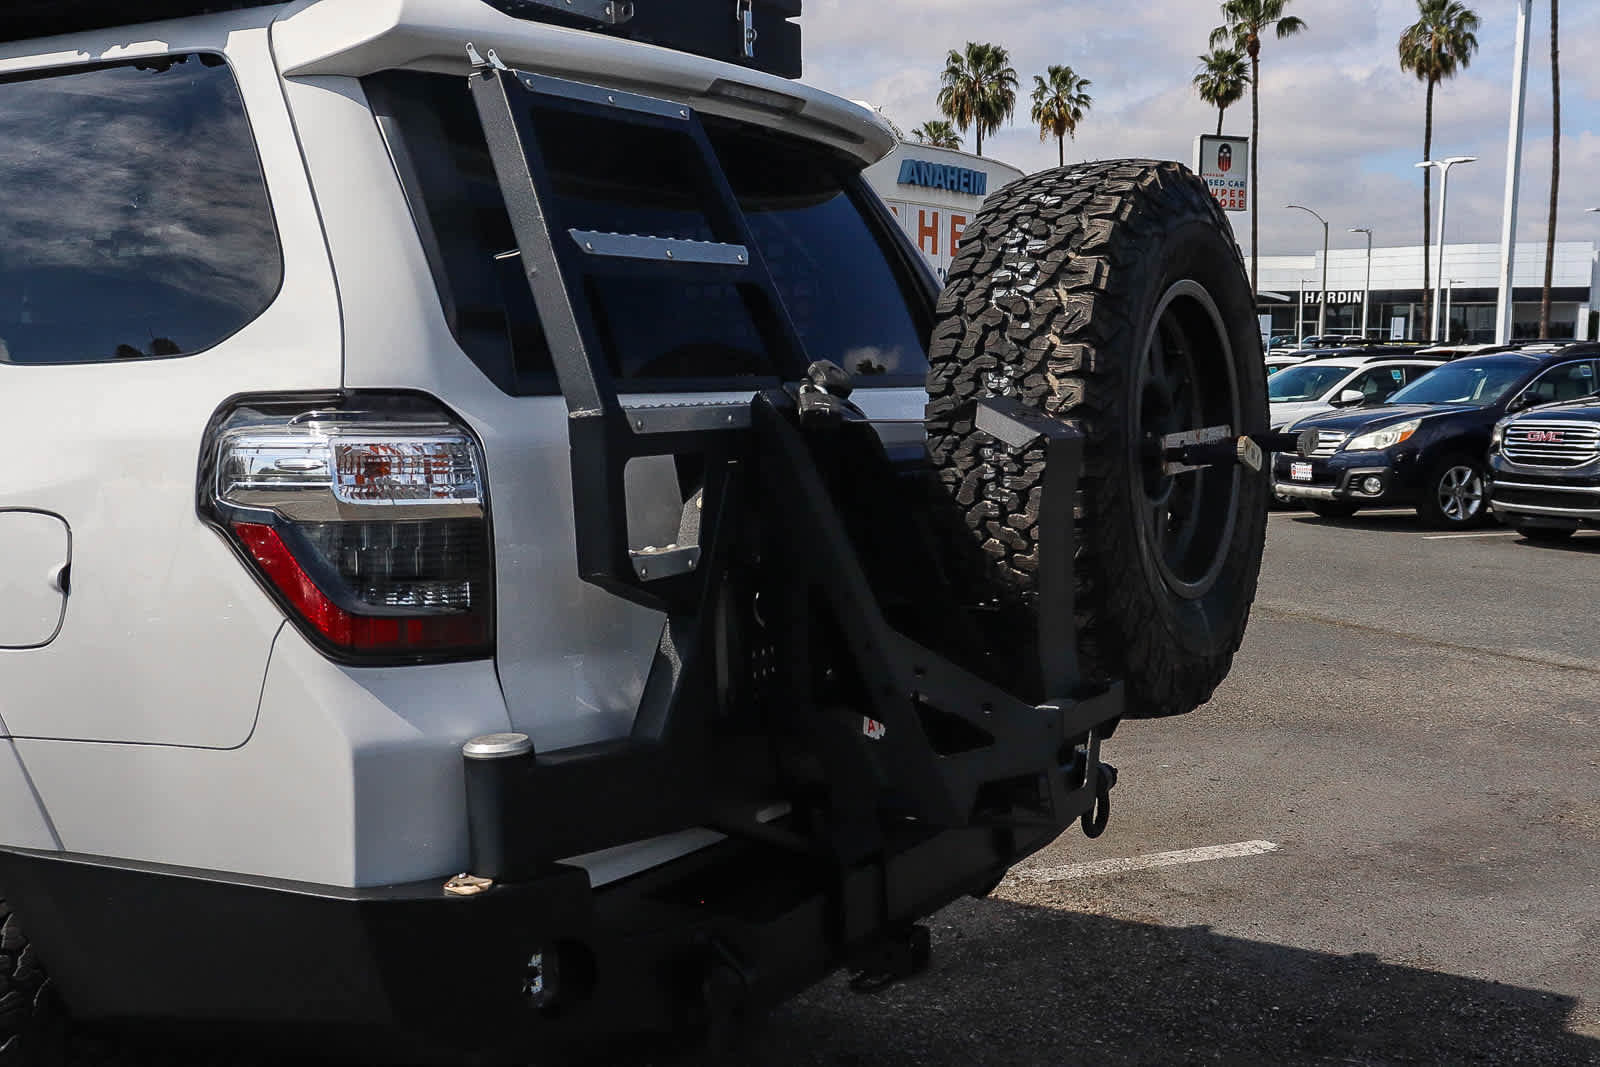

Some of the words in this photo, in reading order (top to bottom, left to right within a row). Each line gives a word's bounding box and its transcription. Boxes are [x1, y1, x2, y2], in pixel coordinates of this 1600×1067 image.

[897, 159, 987, 196] ANAHEIM
[1211, 188, 1245, 198] UPER
[1219, 199, 1245, 208] ORE
[1527, 431, 1564, 442] GMC
